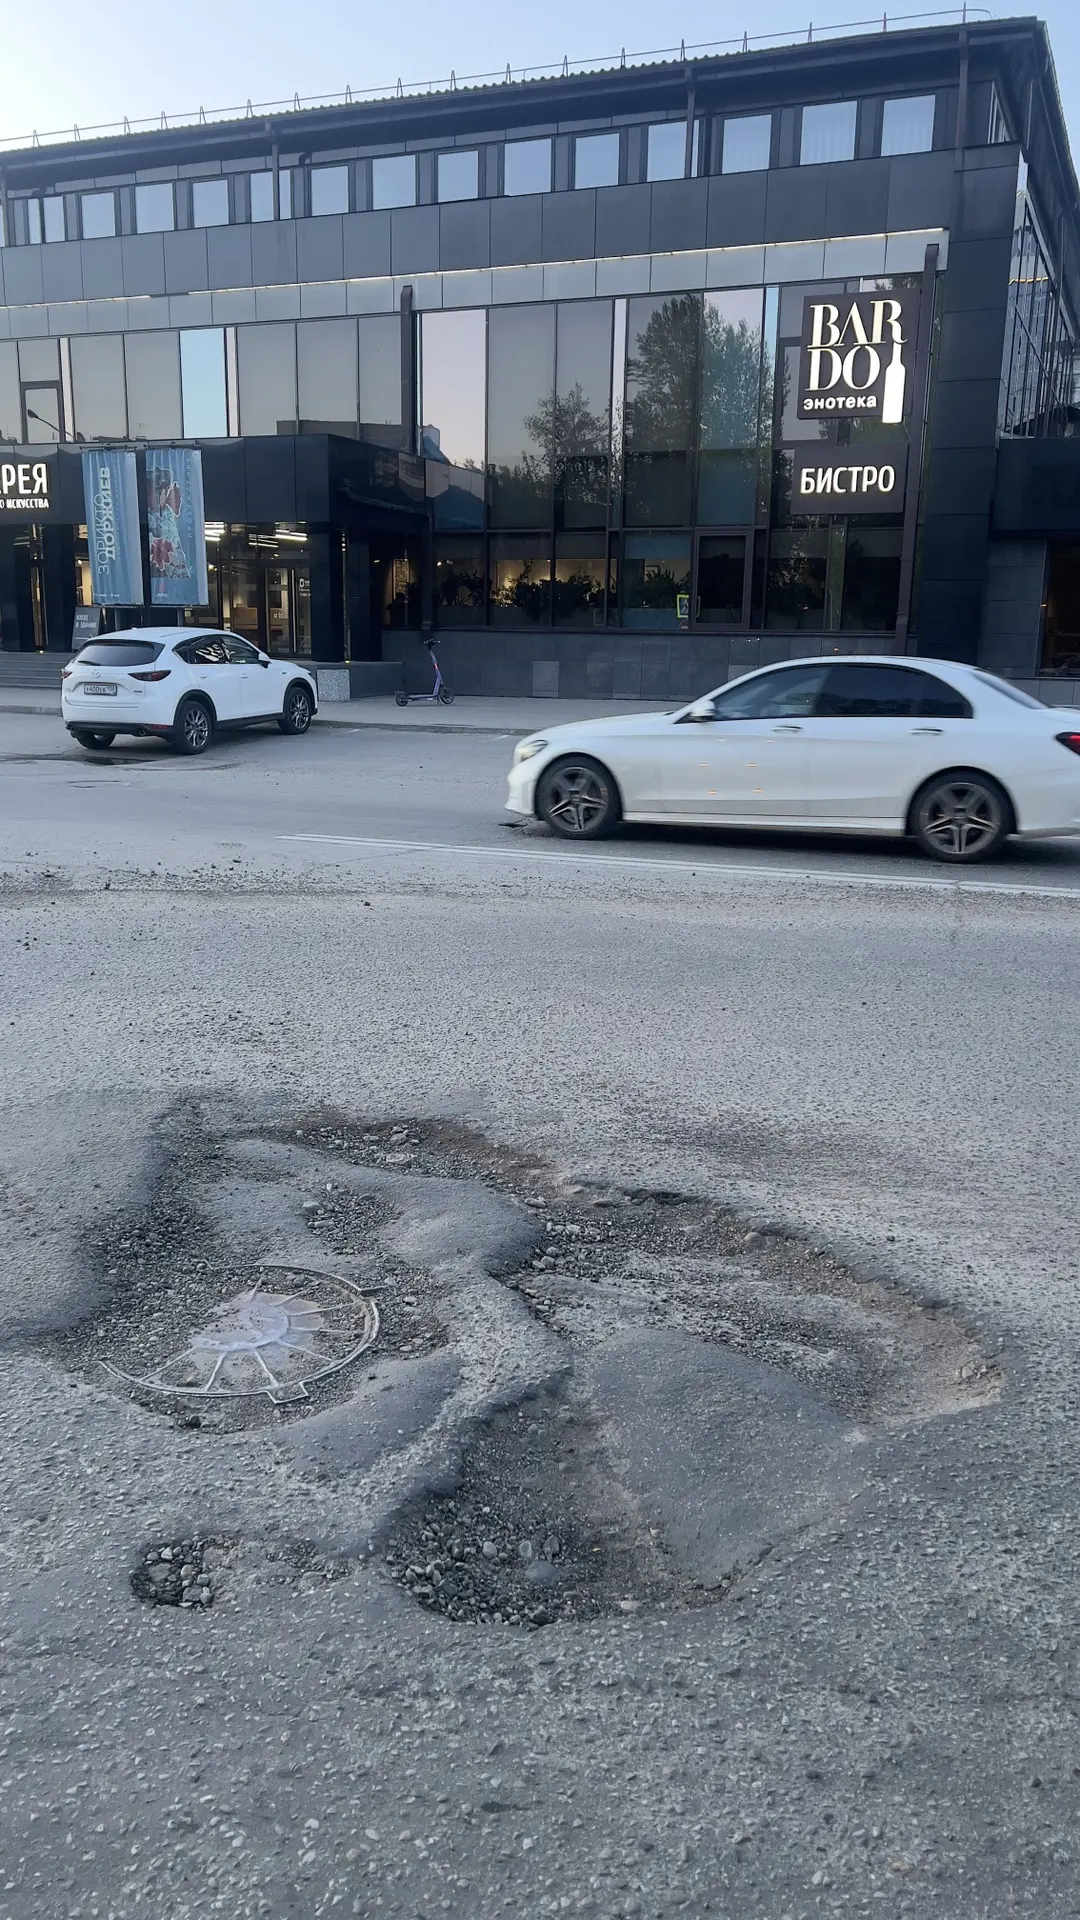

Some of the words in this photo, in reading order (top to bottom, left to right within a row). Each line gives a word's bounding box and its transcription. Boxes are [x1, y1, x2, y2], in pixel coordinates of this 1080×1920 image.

[807, 299, 908, 348] BAR
[805, 345, 880, 391] DO
[803, 395, 877, 410] энотека
[0, 463, 48, 494] РЕЯ
[800, 465, 895, 494] БИСТРО
[6, 498, 49, 509] ИСКУССТВА
[100, 466, 116, 560] ДОРЖИЕВ
[94, 493, 109, 575] ЗОРИКТО
